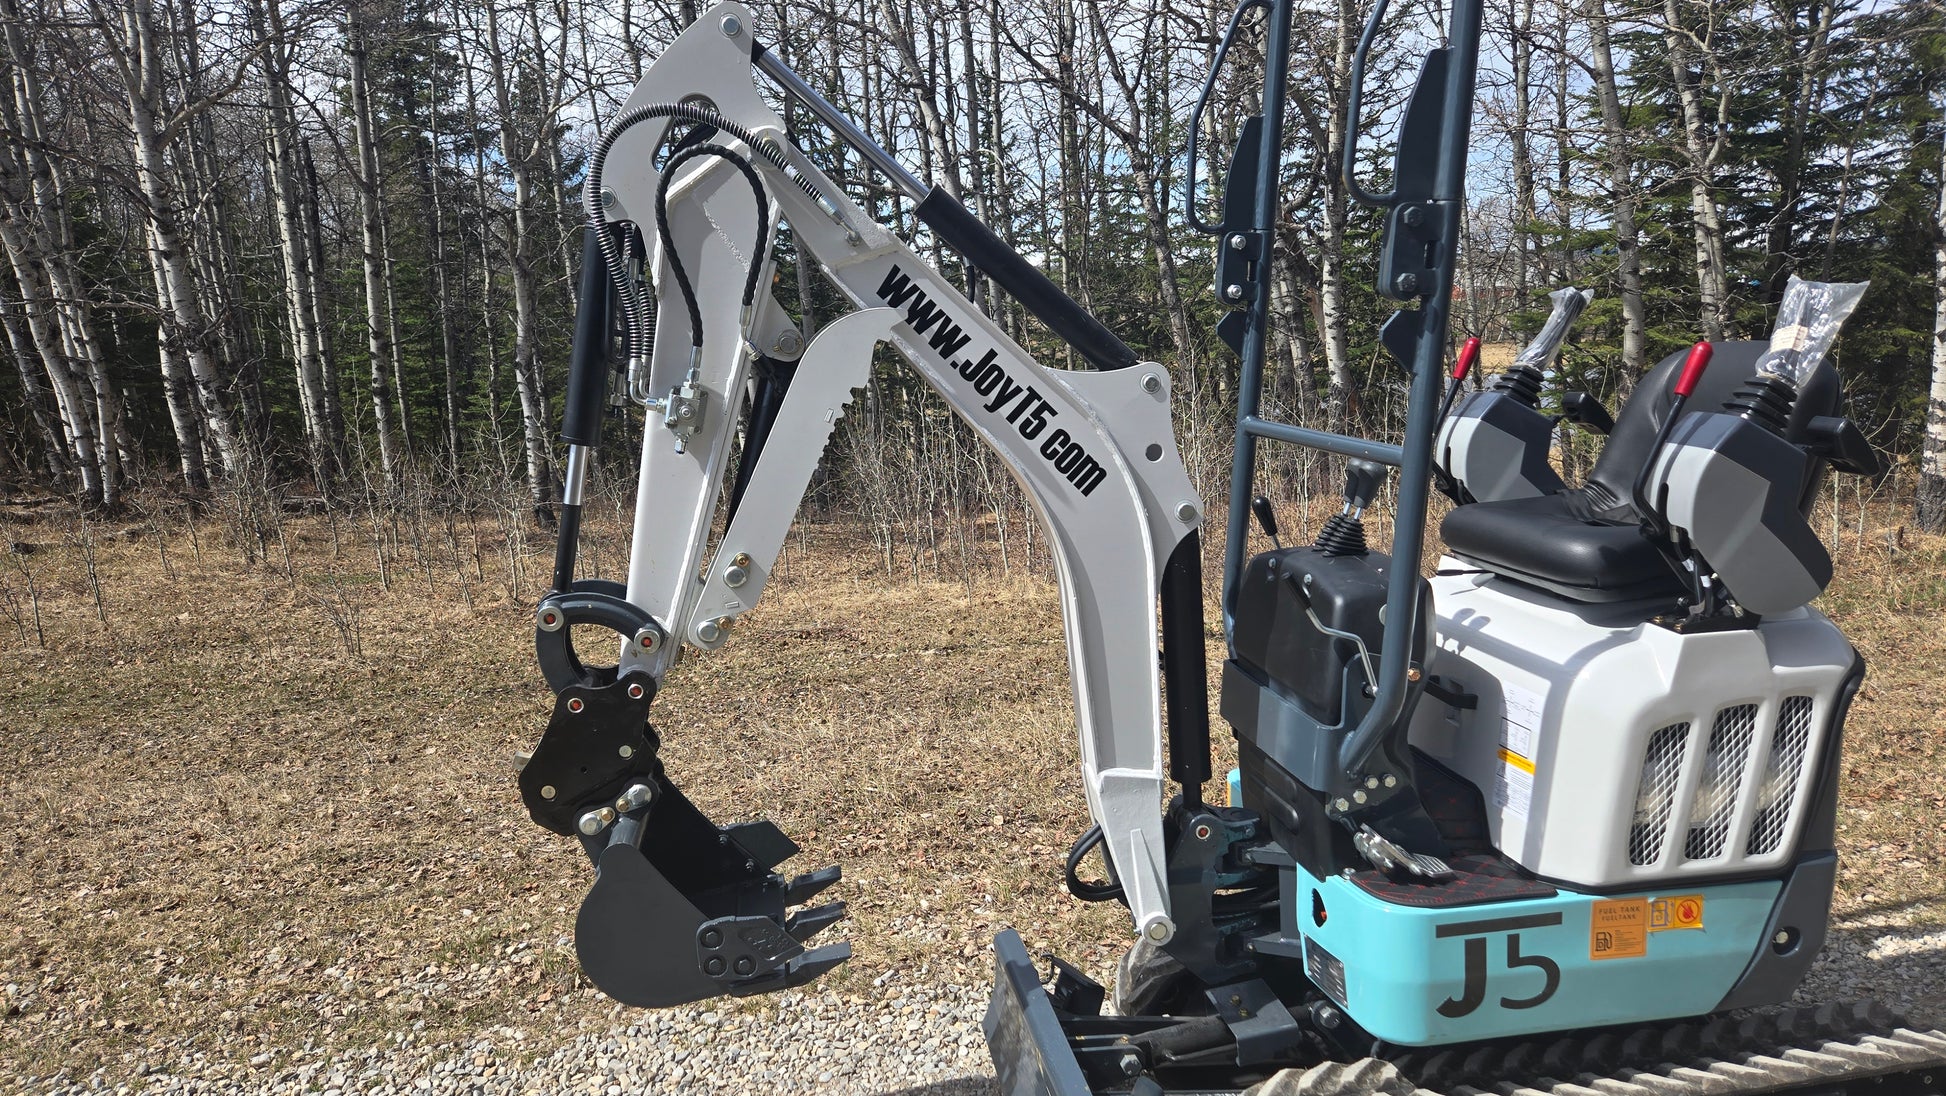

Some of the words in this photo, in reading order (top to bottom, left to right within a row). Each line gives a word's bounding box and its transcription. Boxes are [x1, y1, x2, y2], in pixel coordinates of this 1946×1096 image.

[1040, 429, 1107, 497] com
[1599, 907, 1617, 915] FUEL
[1620, 905, 1640, 913] TANK
